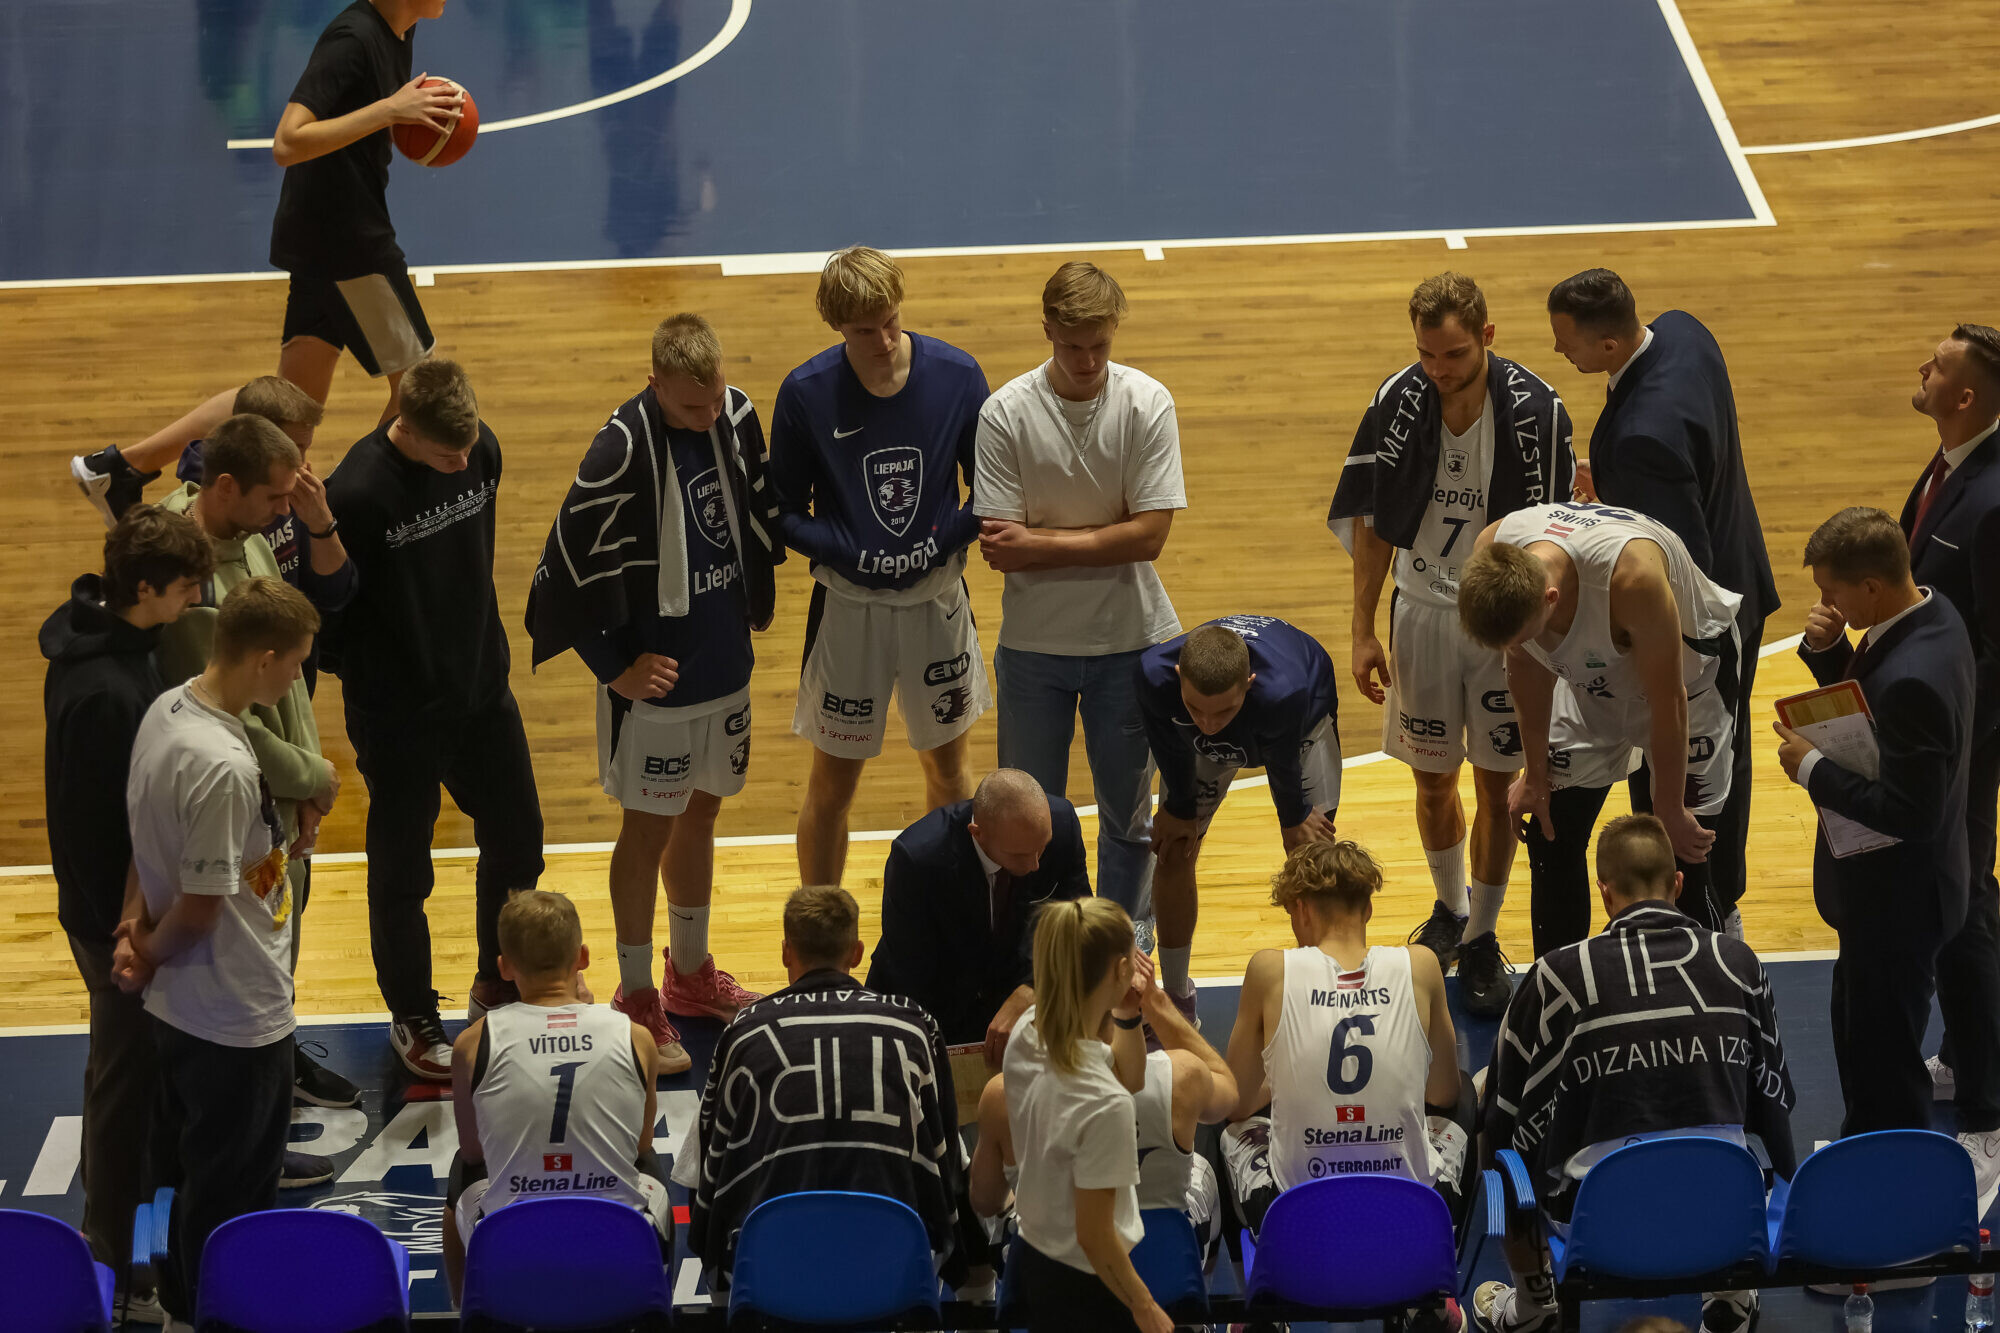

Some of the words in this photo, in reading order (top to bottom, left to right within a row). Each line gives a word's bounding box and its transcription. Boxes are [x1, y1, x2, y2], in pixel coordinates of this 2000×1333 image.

[385, 521, 406, 536] ALL
[457, 489, 474, 502] ON
[1442, 516, 1472, 558] 7
[822, 691, 874, 717] BCS
[828, 730, 874, 742] SPORTLAND
[644, 752, 690, 775] BCS
[529, 1034, 593, 1055] VĪTOLS
[1326, 1013, 1380, 1095] 6
[1572, 1035, 1709, 1084] DIZAINA
[549, 1061, 588, 1144] 1
[1346, 1107, 1355, 1121] S
[1304, 1127, 1363, 1146] Stena
[1364, 1124, 1404, 1142] Line
[553, 1156, 562, 1169] S
[509, 1175, 569, 1194] Stena
[572, 1172, 618, 1191] Line
